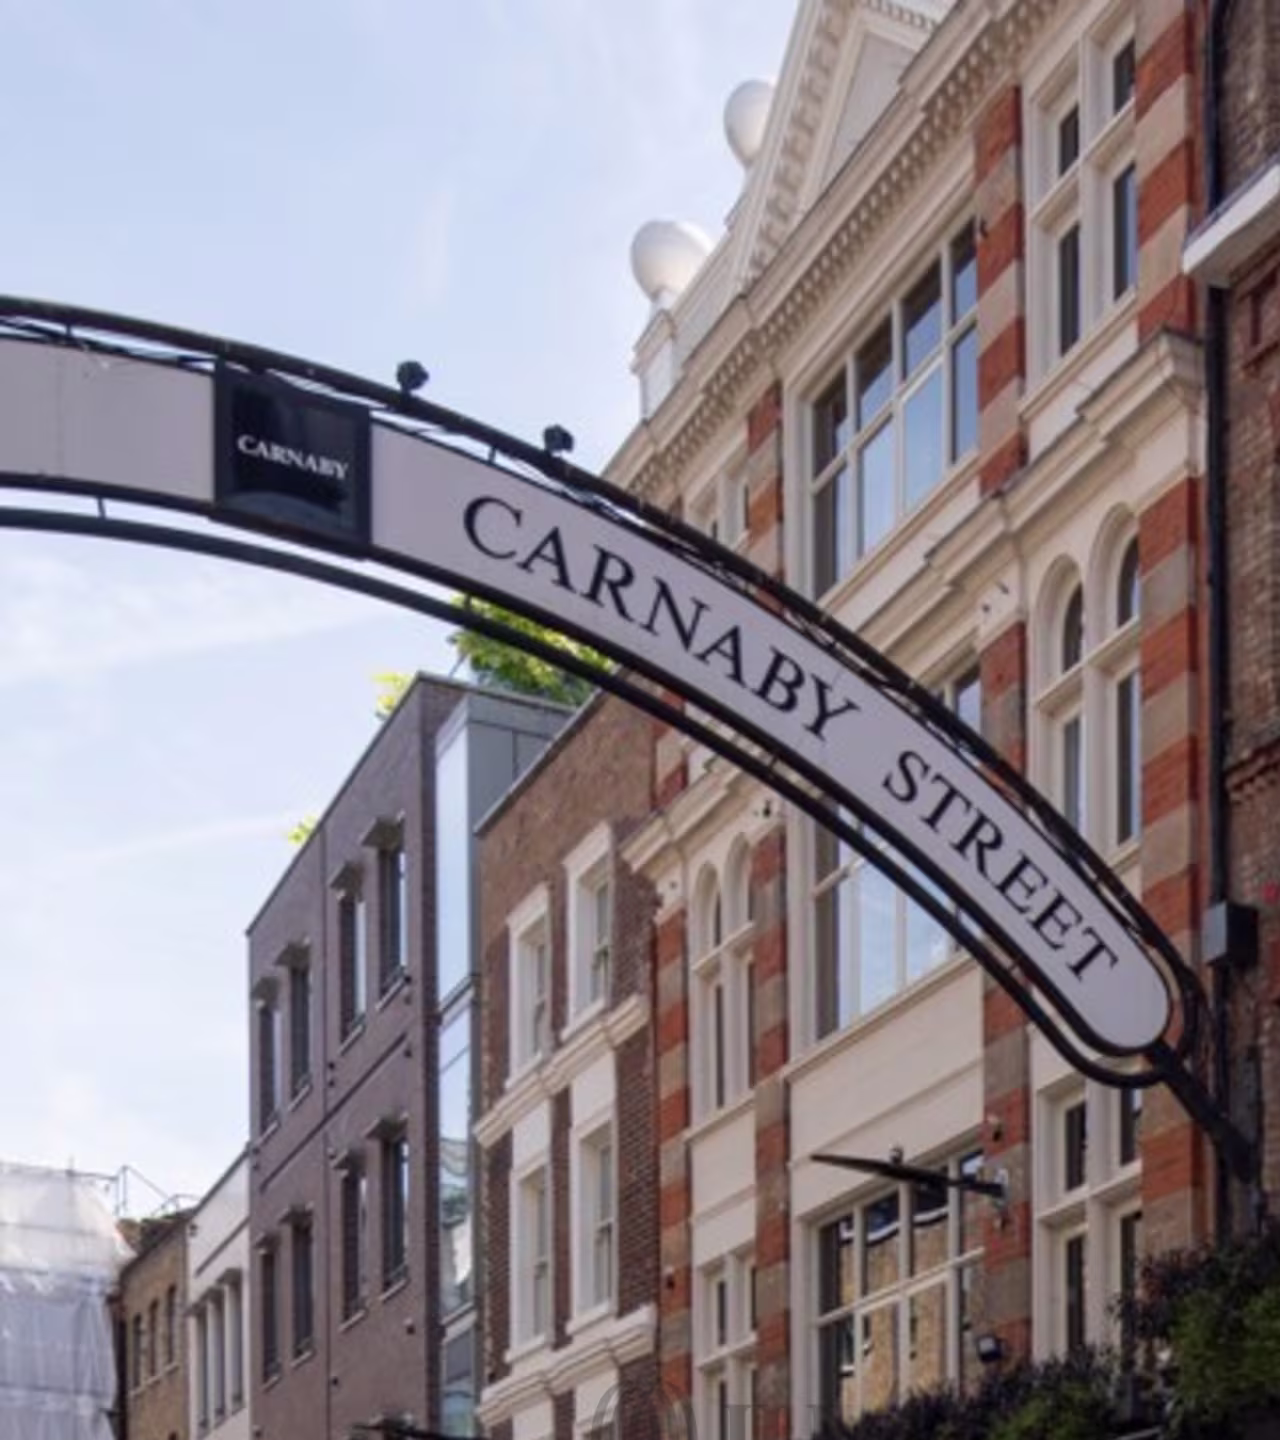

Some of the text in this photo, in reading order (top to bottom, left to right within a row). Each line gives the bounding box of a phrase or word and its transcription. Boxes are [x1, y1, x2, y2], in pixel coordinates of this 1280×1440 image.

[237, 434, 349, 480] CARNABY
[462, 495, 1119, 982] CARNABY STREET
